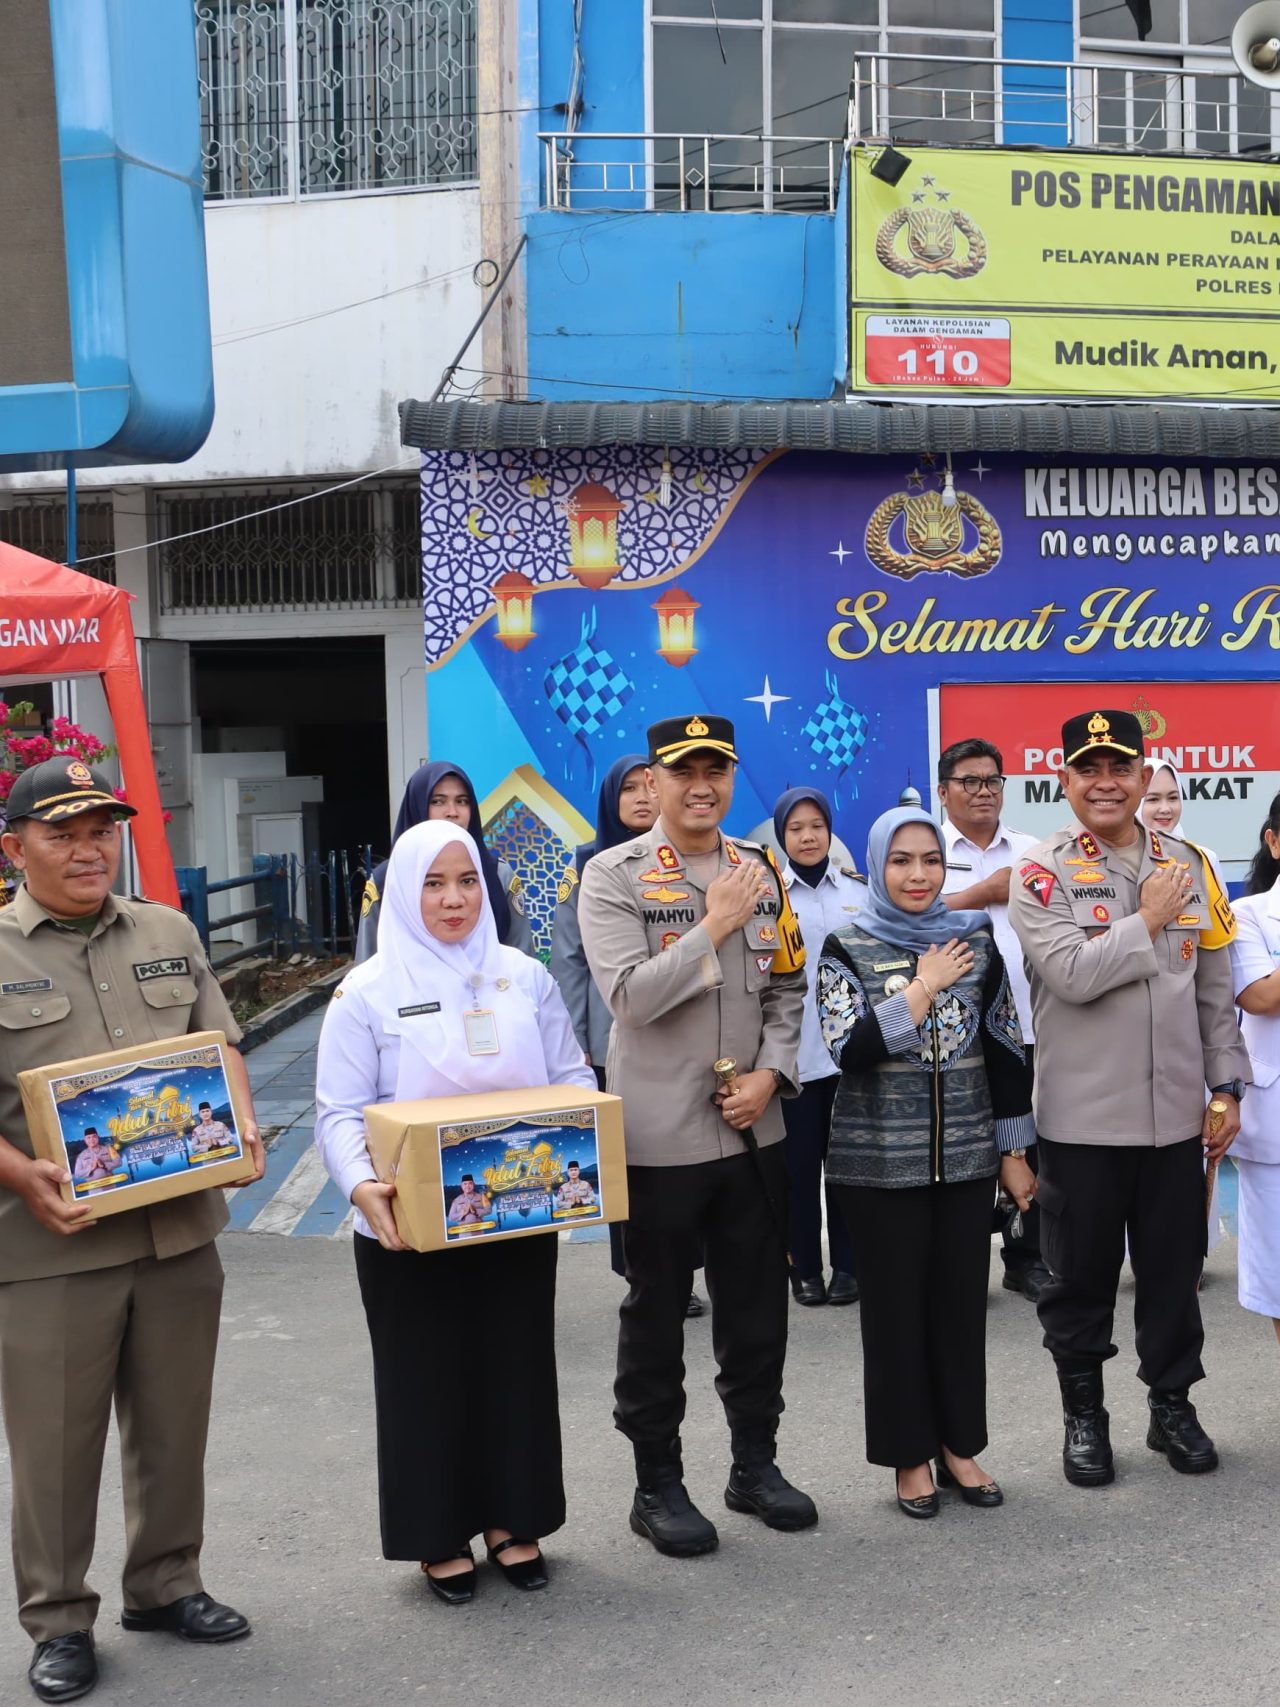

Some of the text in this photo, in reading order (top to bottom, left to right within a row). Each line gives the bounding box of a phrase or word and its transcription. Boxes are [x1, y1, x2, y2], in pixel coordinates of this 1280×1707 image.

[1011, 170, 1081, 208] POS
[1042, 248, 1160, 266] PELAYANAN
[1166, 253, 1269, 270] PERAYAAN
[1196, 279, 1272, 295] POLRES
[885, 318, 991, 328] LAYANAN KEPOLISIAN
[897, 350, 979, 376] 110
[1055, 339, 1160, 368] Mudik
[1167, 344, 1278, 374] Aman,
[1024, 466, 1207, 517] KELUARGA
[826, 589, 1067, 661] Selamat
[1064, 586, 1213, 656] Hari
[1071, 887, 1116, 900] WHISNU
[642, 908, 695, 925] WAHYU
[139, 961, 184, 977] POL-PP
